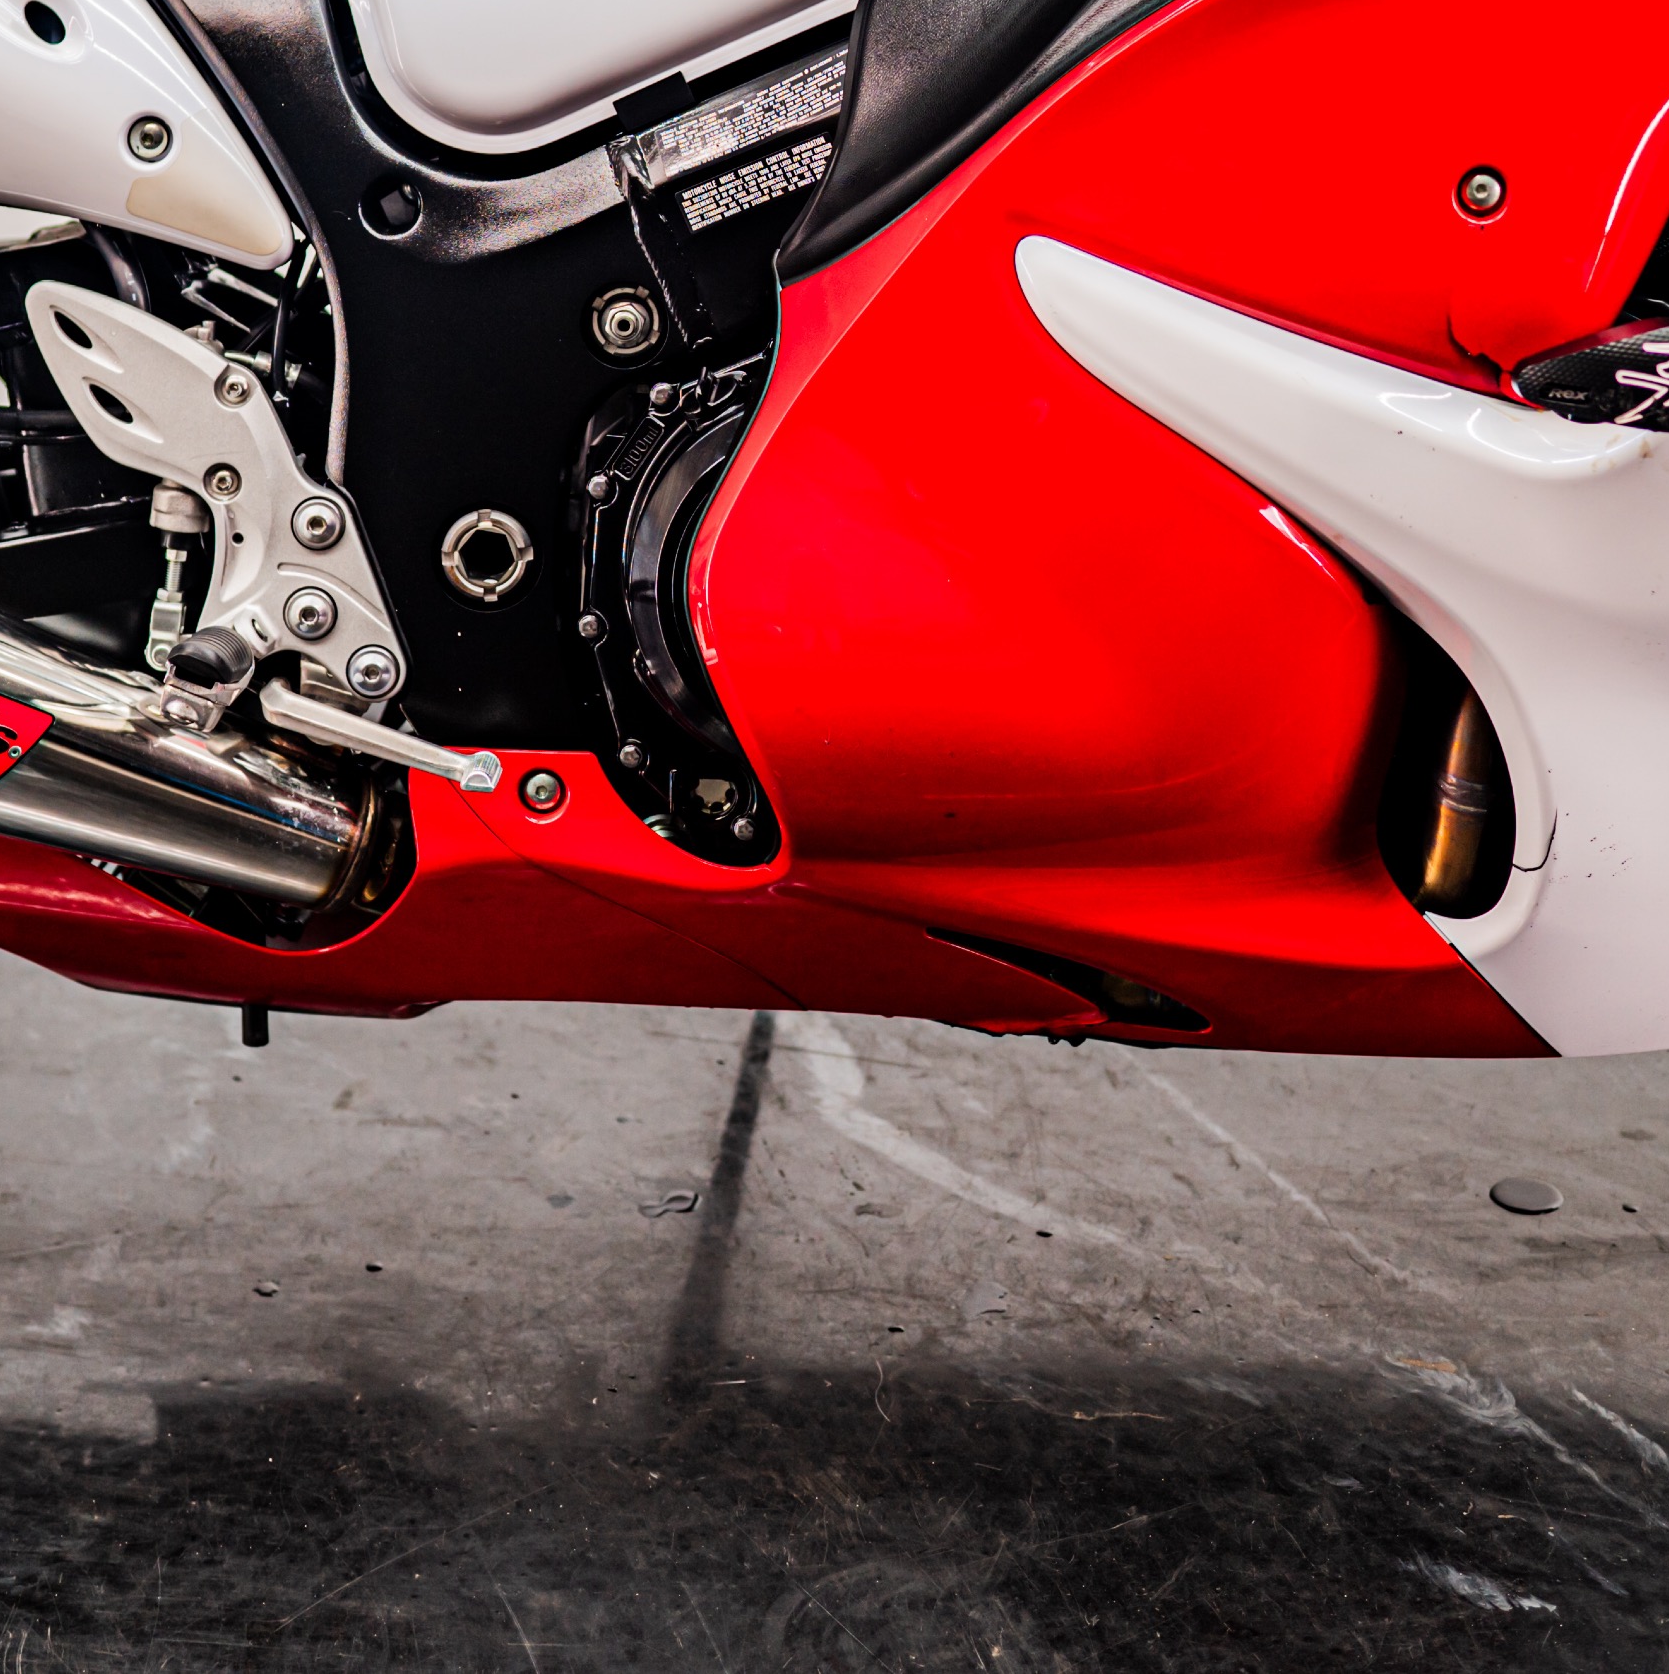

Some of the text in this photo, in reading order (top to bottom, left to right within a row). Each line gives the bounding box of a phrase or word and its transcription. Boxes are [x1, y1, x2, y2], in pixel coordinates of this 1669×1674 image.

[681, 179, 717, 199] MOTORCYCLE
[718, 172, 736, 184] NOISE
[737, 160, 764, 177] EMISSION
[765, 150, 789, 165] CONTROL
[790, 135, 825, 155] INFORMATION
